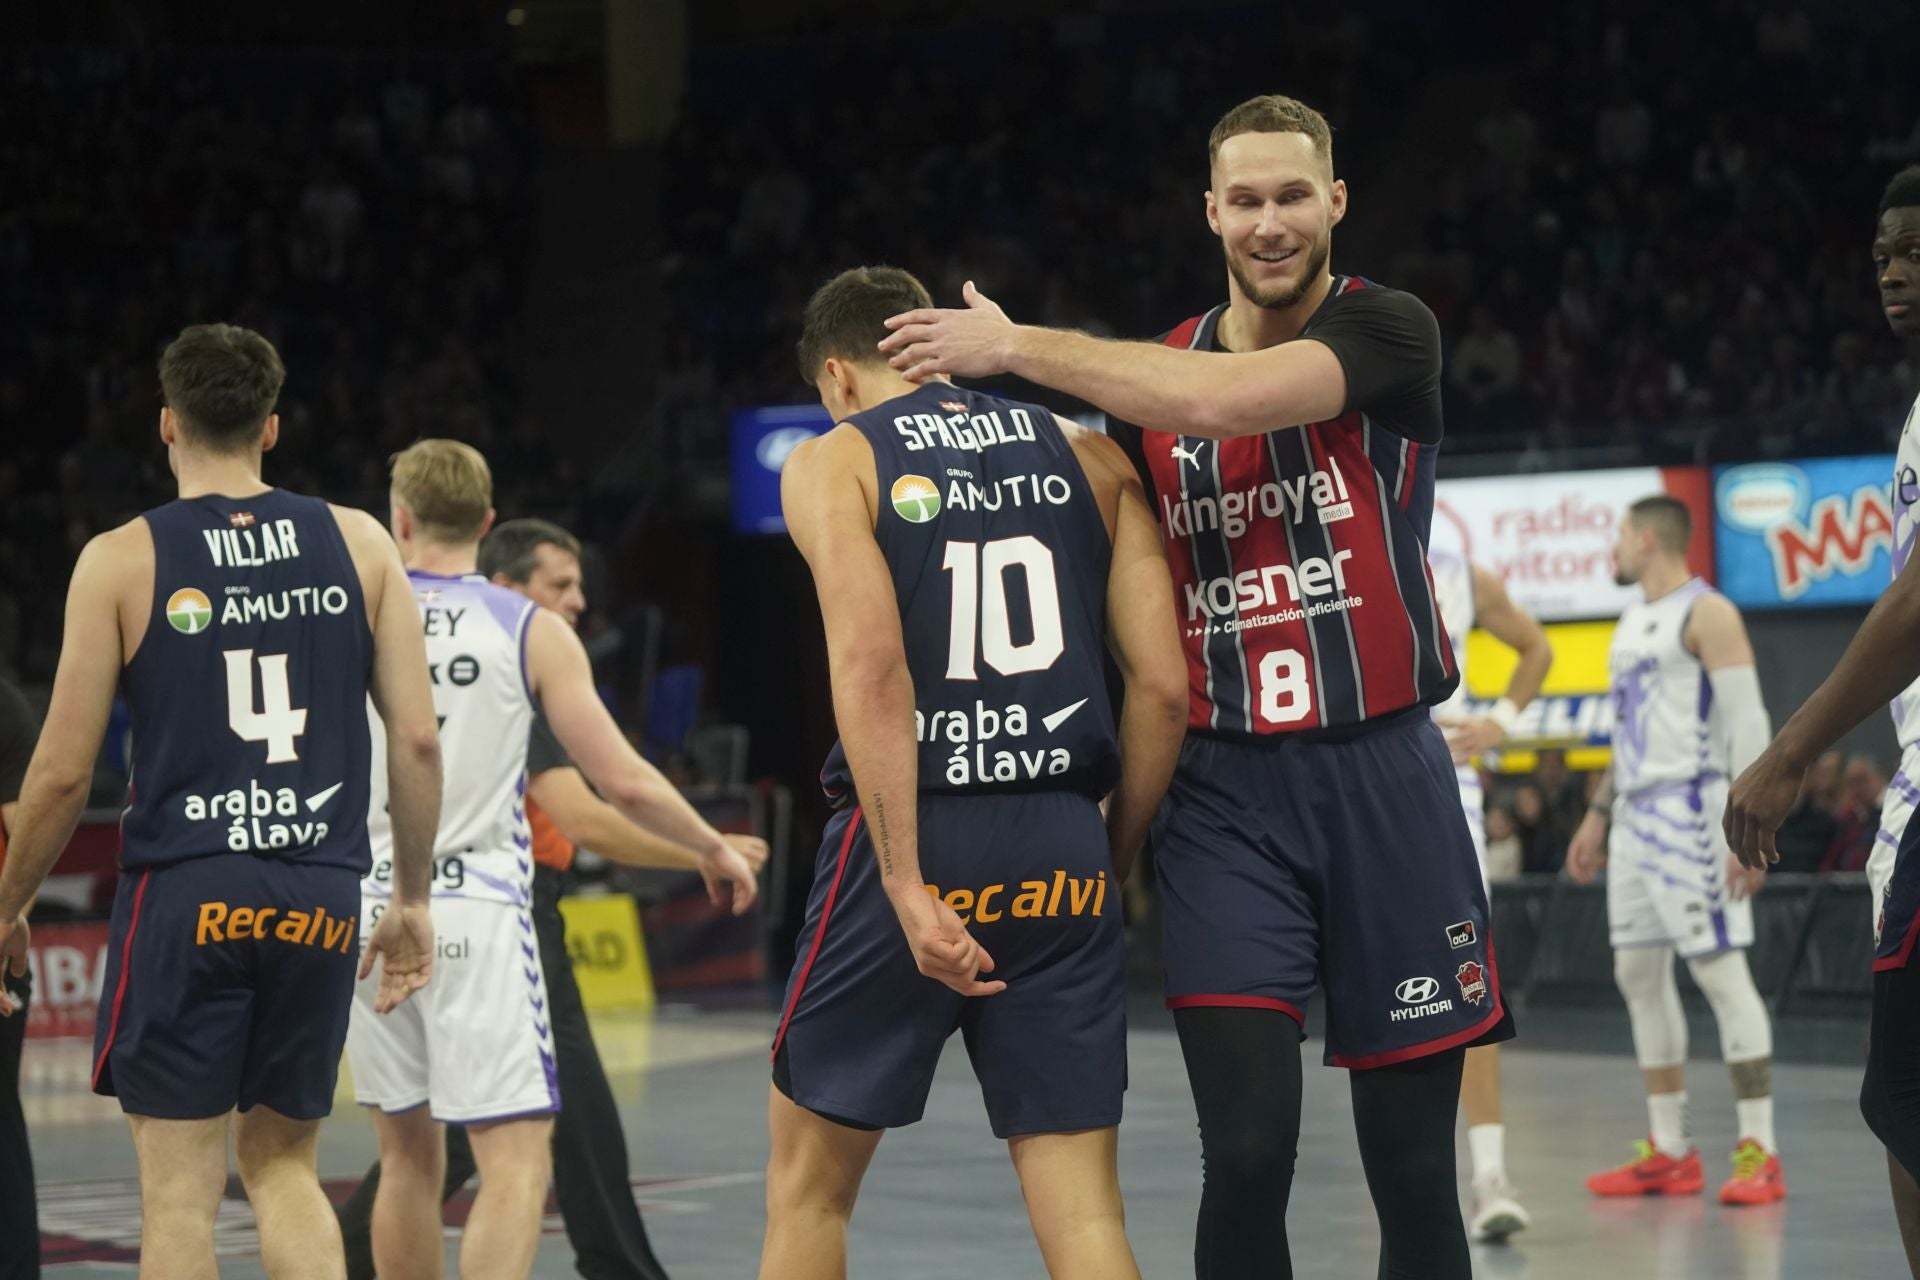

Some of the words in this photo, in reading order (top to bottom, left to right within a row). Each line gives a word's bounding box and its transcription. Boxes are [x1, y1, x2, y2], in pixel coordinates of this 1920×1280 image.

[946, 468, 974, 479] GRUPO
[946, 473, 1071, 511] AMUTIO
[1163, 456, 1349, 539] kingroyal
[1322, 505, 1351, 520] media
[203, 518, 300, 567] VILLAR
[1774, 493, 1893, 592] MA
[221, 585, 348, 625] AMUTIO
[1184, 549, 1353, 621] kosner
[424, 608, 466, 637] EY
[942, 535, 1065, 681] 10
[1224, 609, 1305, 634] Climatización
[1307, 595, 1363, 617] eficiente
[222, 648, 308, 765] 4
[1258, 648, 1311, 724] 8
[946, 744, 1071, 785] álava
[184, 779, 298, 821] araba
[196, 901, 356, 955] Recalvi
[1452, 932, 1469, 945] acb
[1390, 999, 1453, 1022] HYUNDAI
